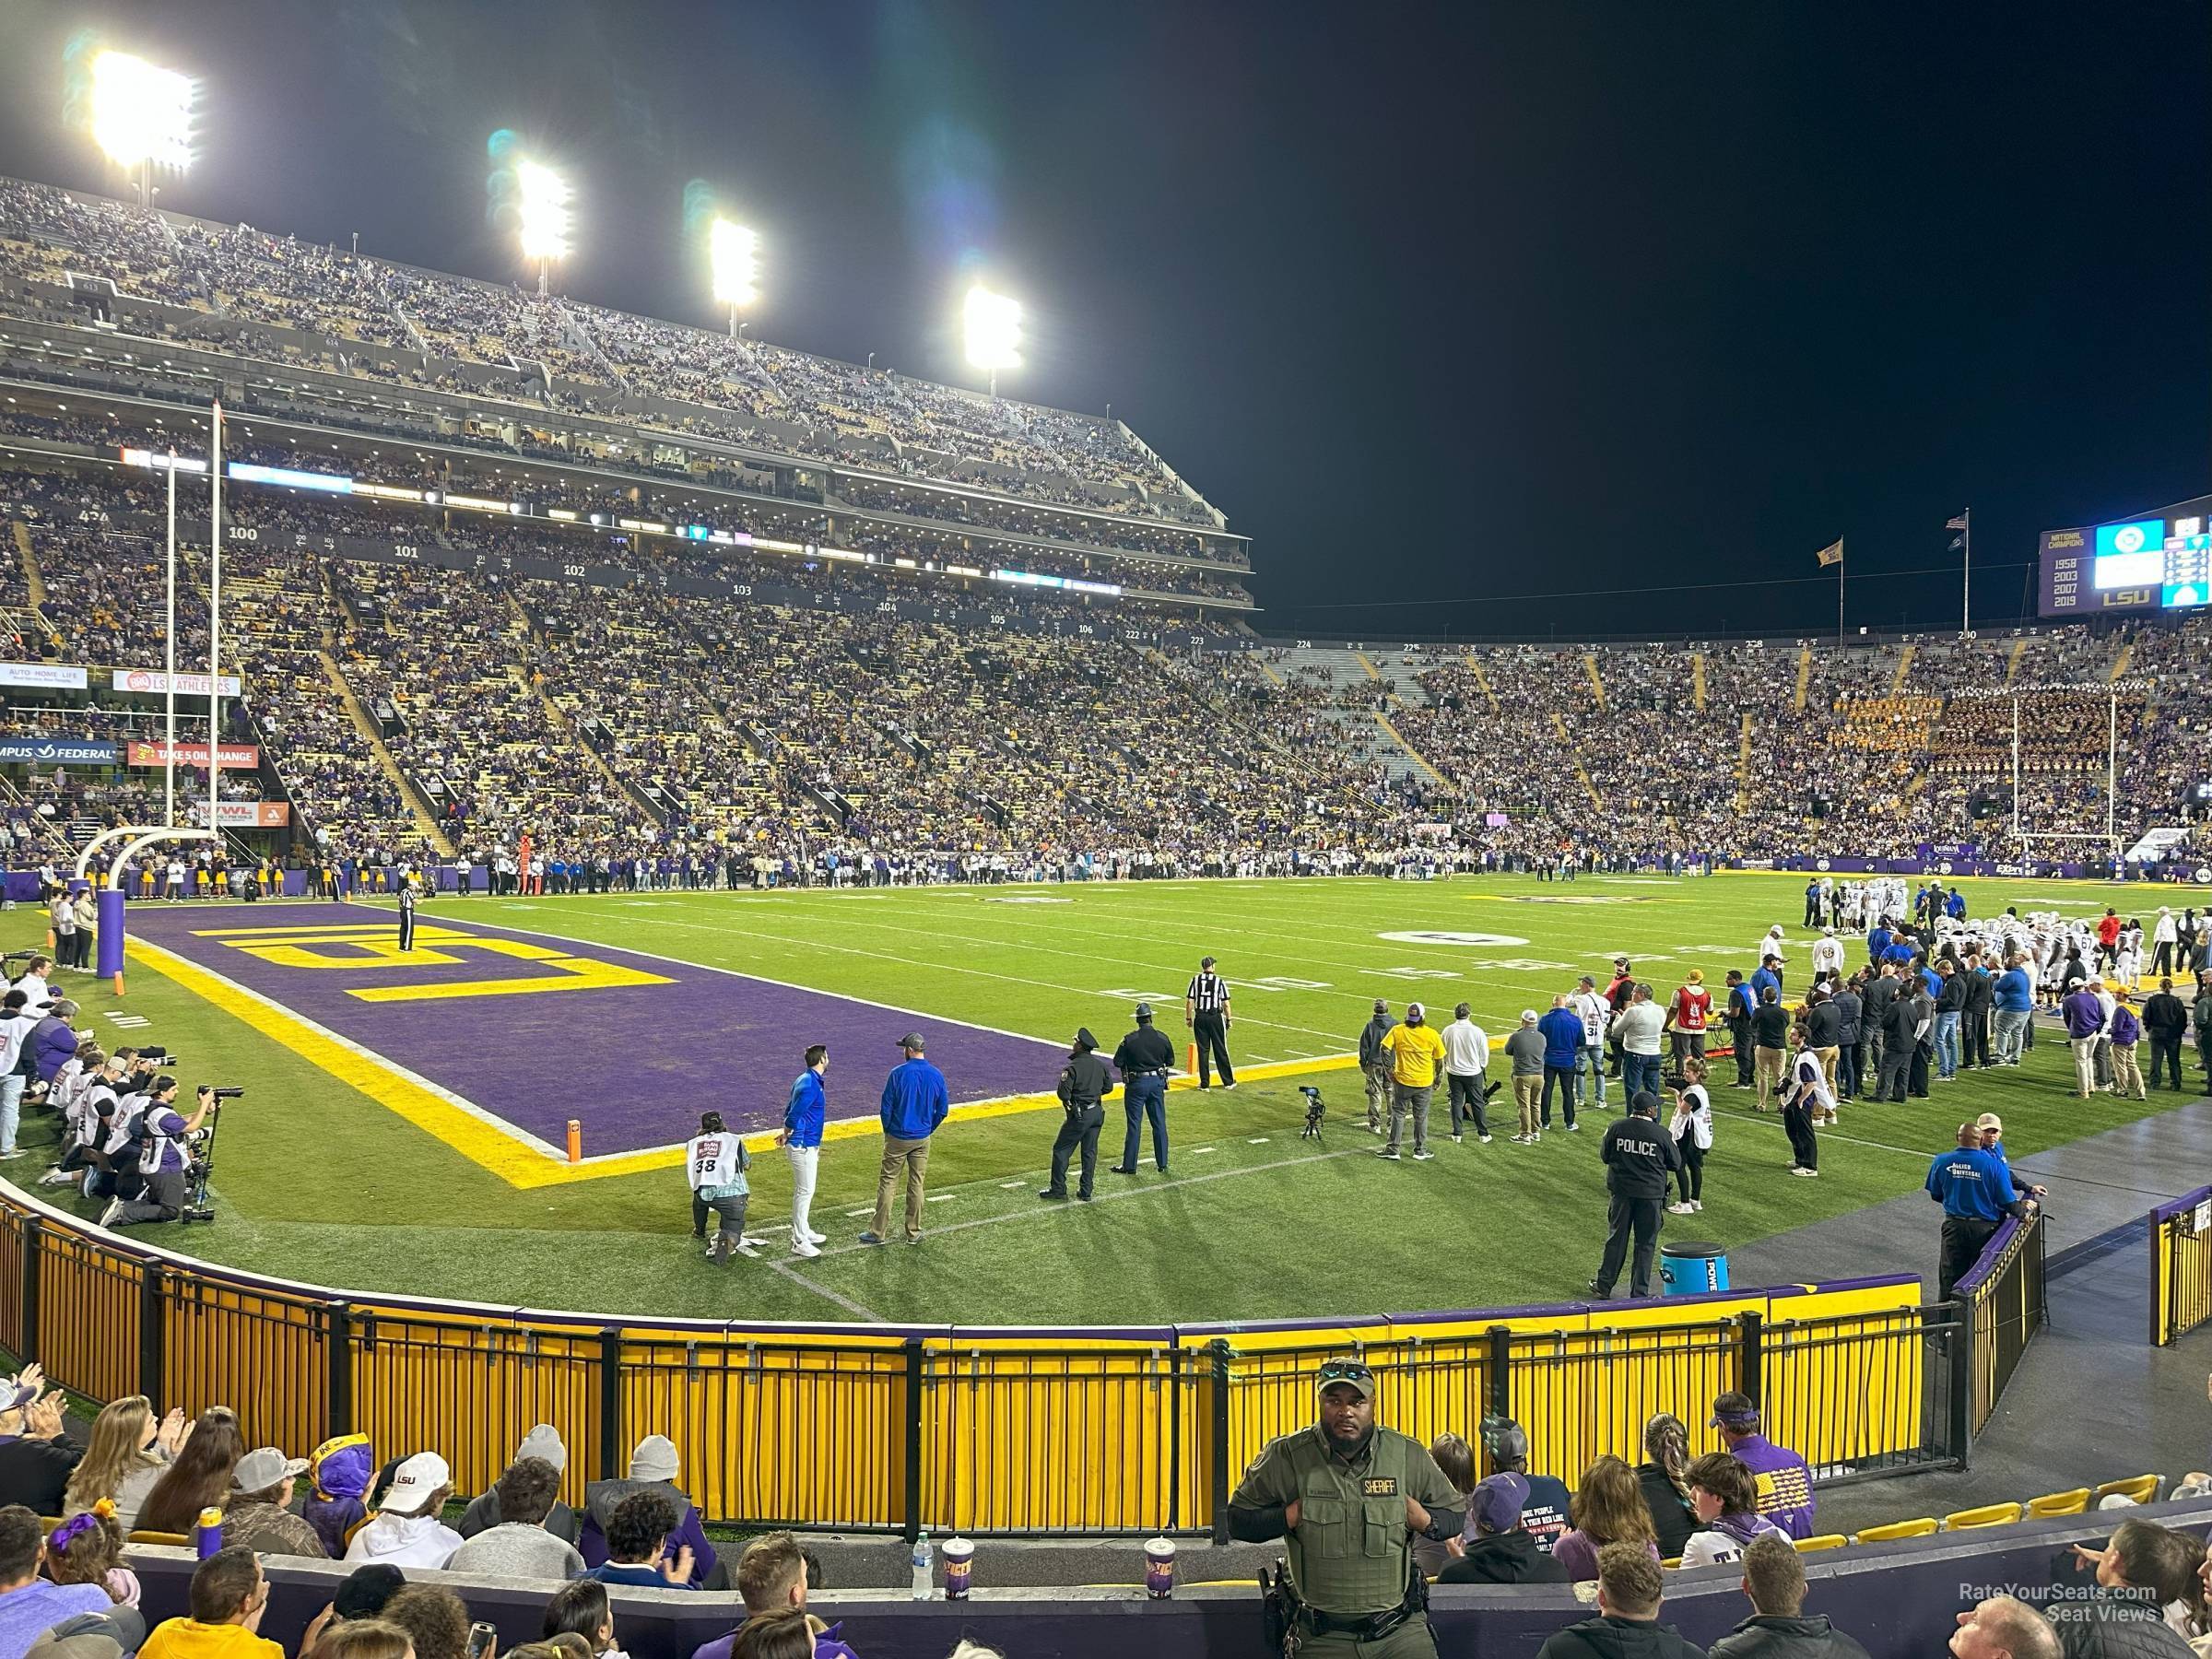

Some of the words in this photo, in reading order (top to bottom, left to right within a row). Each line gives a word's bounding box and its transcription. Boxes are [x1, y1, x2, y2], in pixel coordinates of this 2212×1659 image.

[229, 526, 257, 541] 100
[2051, 532, 2081, 542] NATIONAL
[2048, 539, 2084, 549] CHAMPIONS
[394, 545, 418, 559] 101
[2055, 559, 2077, 570] 1958
[564, 565, 585, 577] 102
[2054, 571, 2077, 582] 2003
[733, 585, 751, 596] 103
[2054, 583, 2077, 594] 2007
[2054, 595, 2076, 607] 2019
[2103, 590, 2150, 606] LSU
[879, 602, 897, 612] 104
[990, 614, 1006, 625] 105
[1078, 624, 1093, 634] 106
[1125, 629, 1140, 640] 222
[130, 676, 147, 688] BRO
[176, 681, 230, 693] ATHLETCS
[57, 748, 112, 759] FEDERAL
[185, 751, 192, 760] 5
[193, 751, 209, 760] OIL
[218, 752, 252, 761] HANGE
[1992, 939, 2004, 953] 76
[2081, 936, 2093, 950] 67
[1201, 980, 1211, 996] L
[1616, 1137, 1657, 1157] POLICE
[696, 1159, 716, 1173] 38
[1952, 1169, 1981, 1178] UNIVERSAL
[1707, 1262, 1718, 1291] POWE
[397, 1476, 417, 1485] LSU
[1365, 1479, 1394, 1493] SHERIFF
[1534, 1505, 1554, 1516] PEOPLE
[1527, 1517, 1541, 1527] THIN
[1542, 1515, 1552, 1524] RED
[1552, 1513, 1564, 1523] LINE
